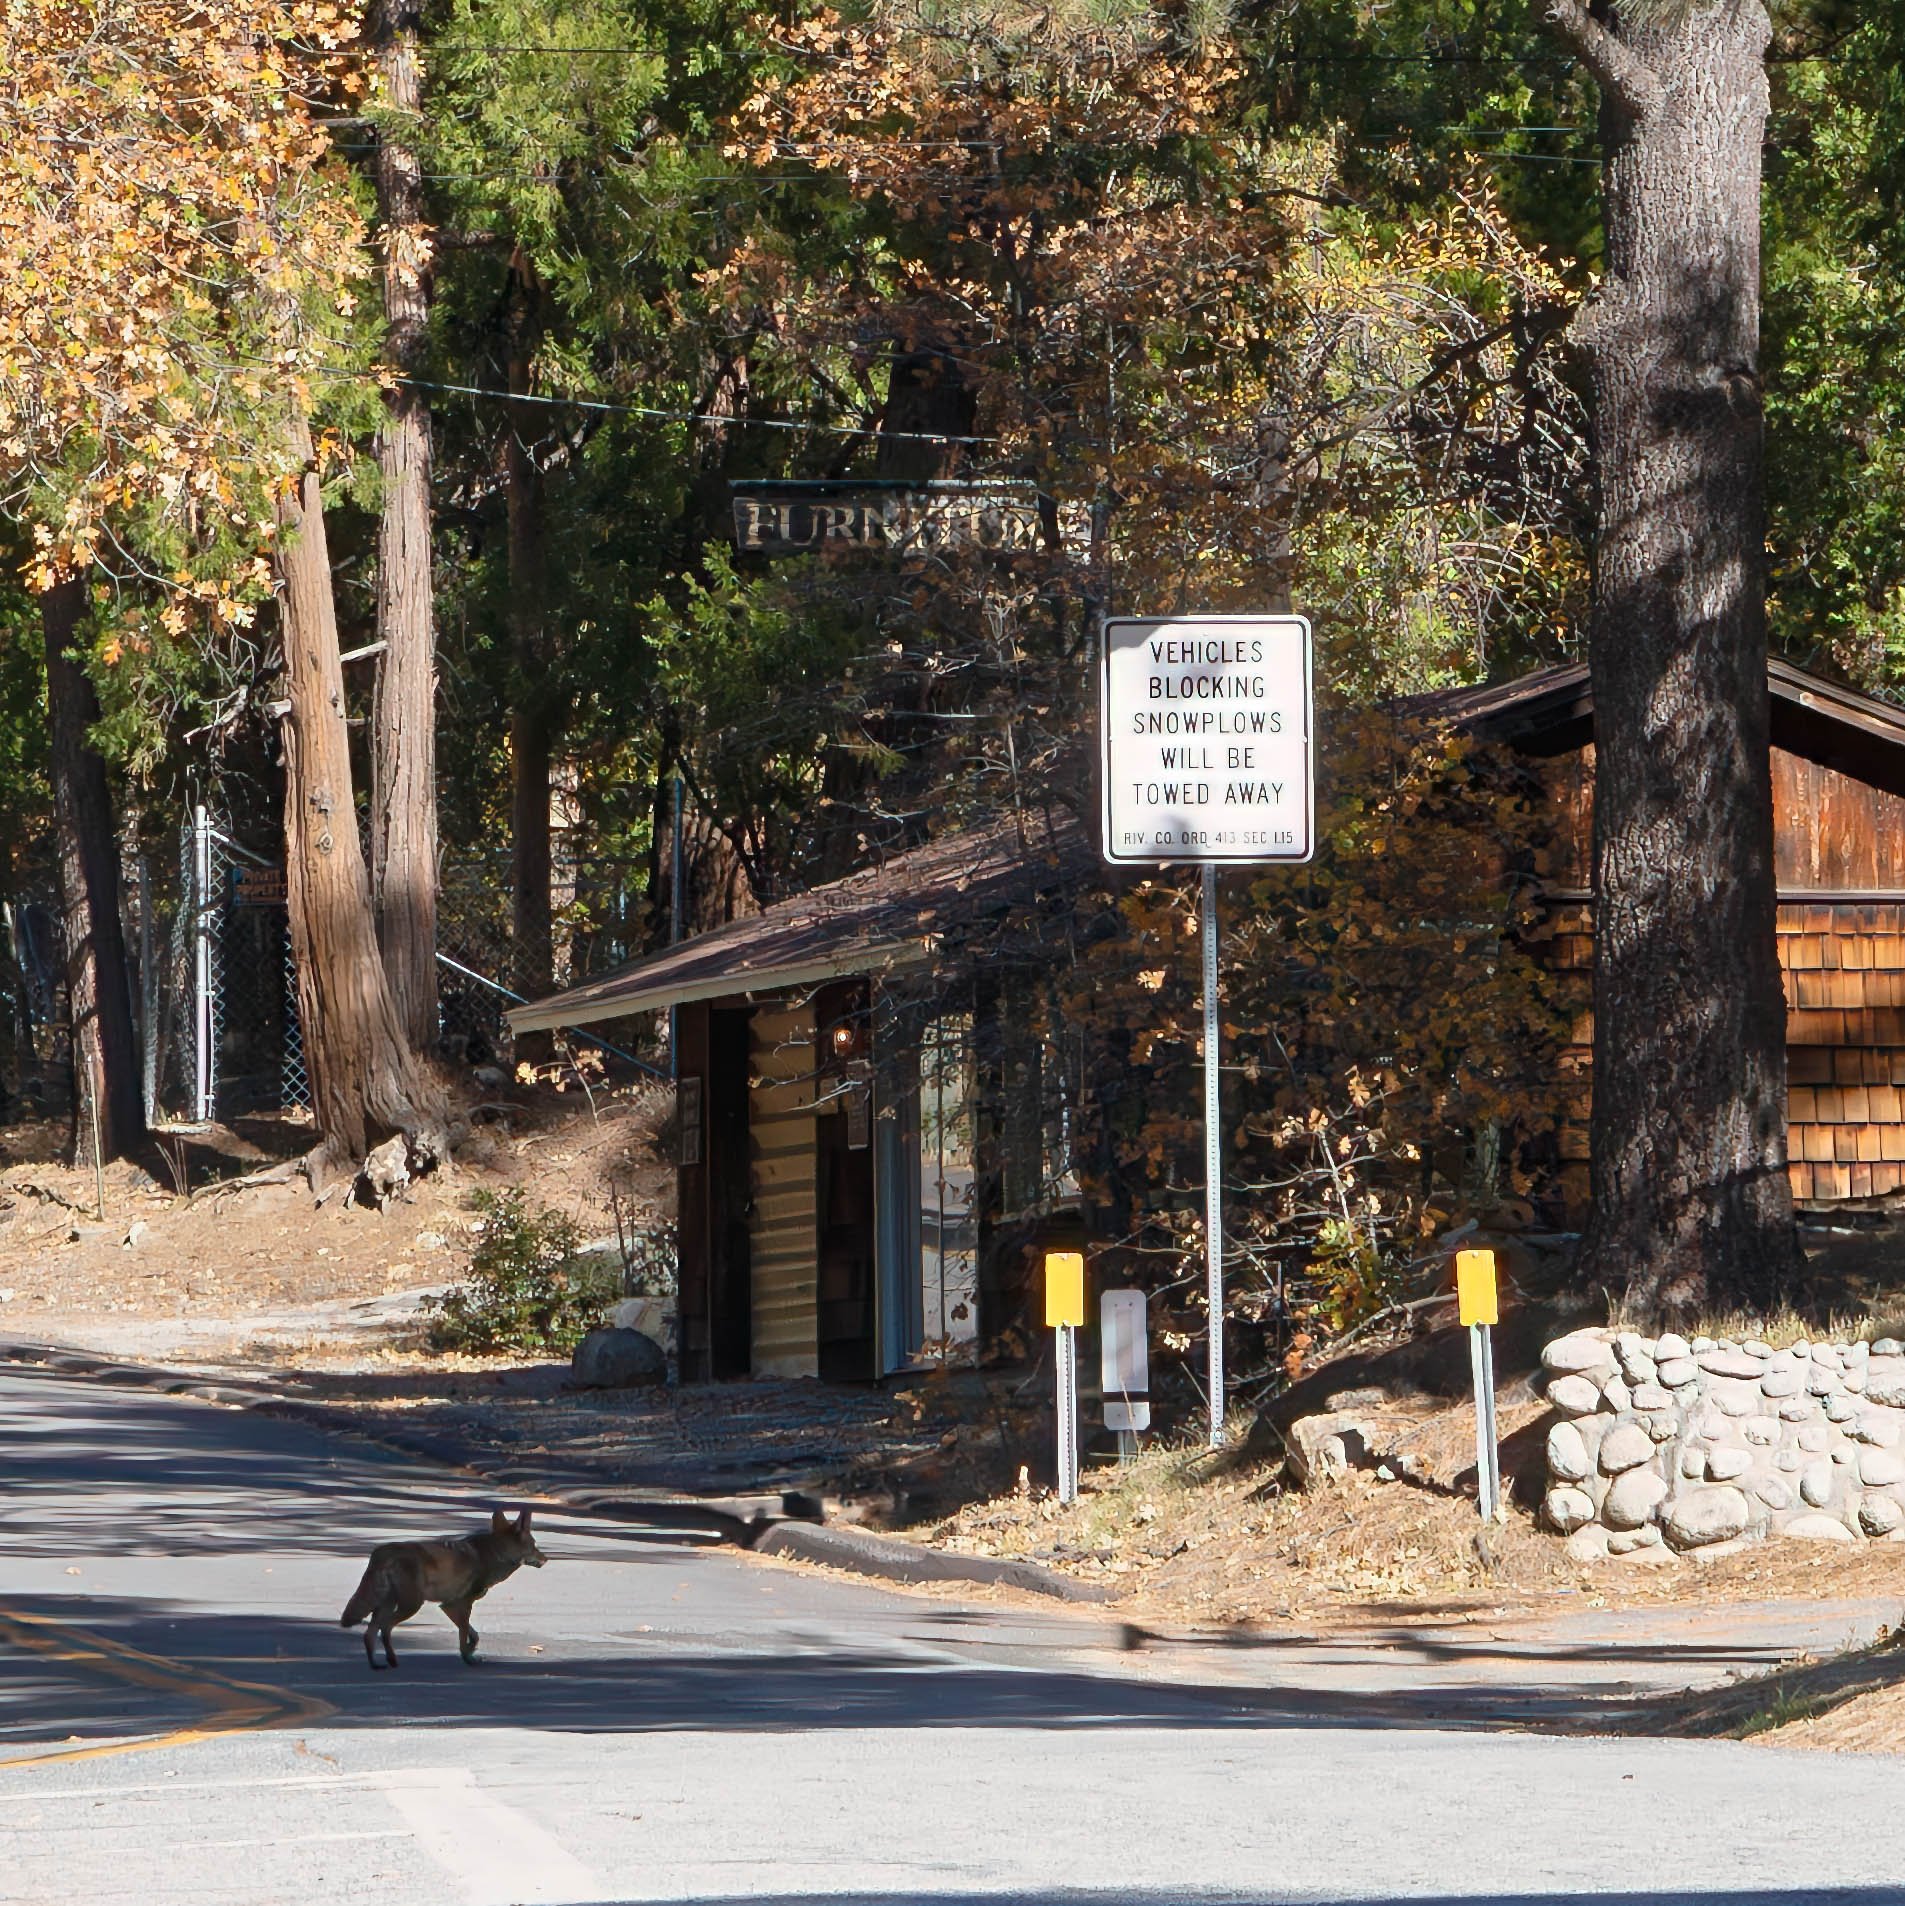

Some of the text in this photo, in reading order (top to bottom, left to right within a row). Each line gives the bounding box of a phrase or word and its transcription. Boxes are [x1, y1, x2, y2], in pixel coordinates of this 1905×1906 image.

[744, 503, 1093, 551] FURNTU
[1150, 641, 1263, 664] VEHICLES
[1149, 676, 1264, 699] BLOCKING
[1133, 711, 1282, 734] SNOWPLOWS
[1161, 747, 1255, 769] WILL BE
[1132, 783, 1284, 805] TOWED AWAY
[1215, 831, 1236, 844] 413
